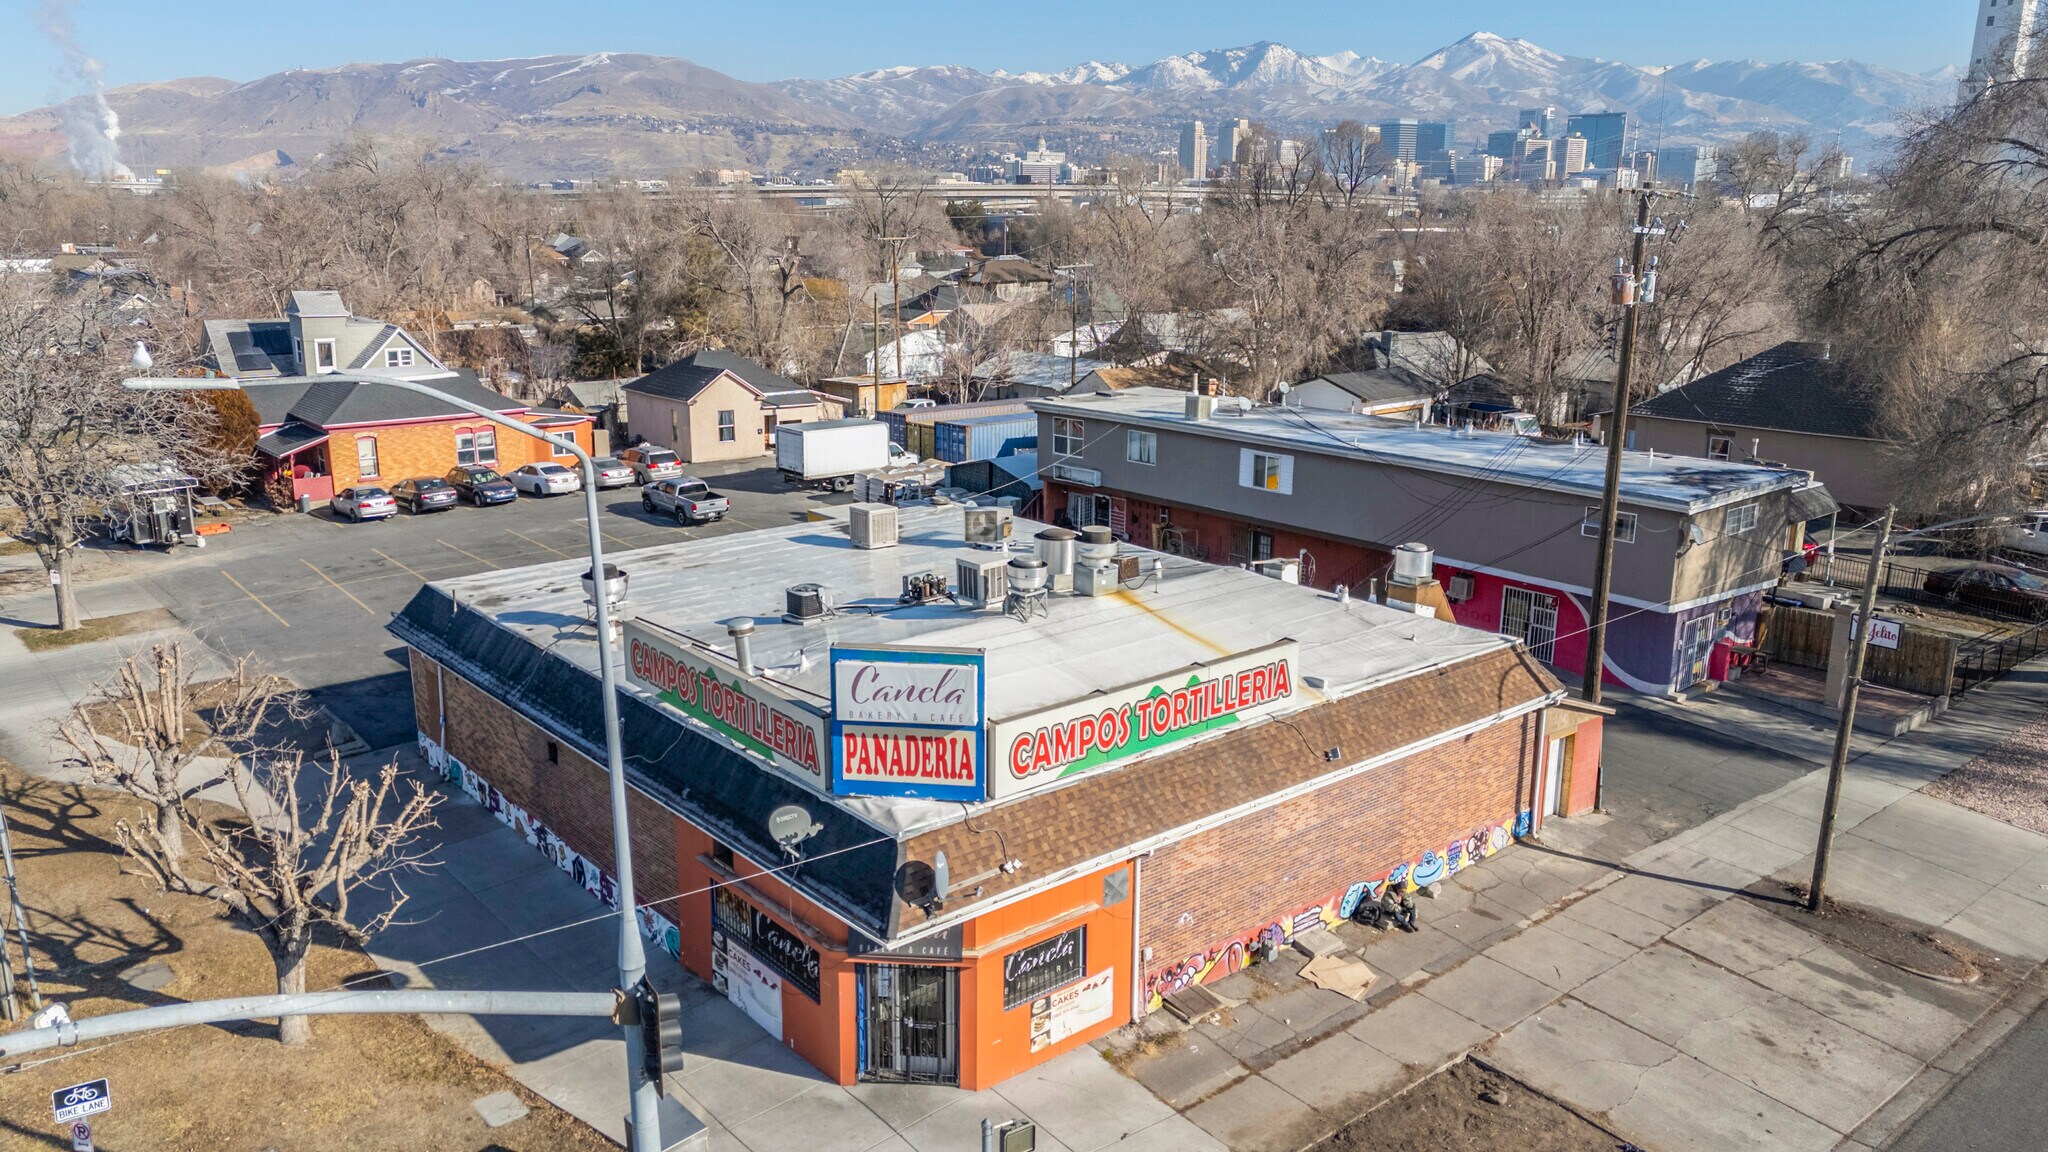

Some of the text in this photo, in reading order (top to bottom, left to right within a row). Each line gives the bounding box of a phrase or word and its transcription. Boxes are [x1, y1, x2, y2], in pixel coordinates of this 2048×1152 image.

[850, 665, 965, 705] Canela
[631, 638, 820, 776] CAMPOS TORTILLERIA
[849, 711, 964, 723] BAKERY & CAFÉ
[1009, 659, 1292, 779] CAMPOS TORTILLERIA
[844, 733, 974, 780] PANADERIA
[780, 813, 798, 822] DIRECTV
[728, 948, 751, 972] CAKES
[859, 944, 899, 953] BAKEY
[922, 946, 948, 955] CAFÉ
[1005, 931, 1075, 982] Canela
[1052, 990, 1079, 1007] CAKES
[59, 1099, 106, 1119] BIKE LANE
